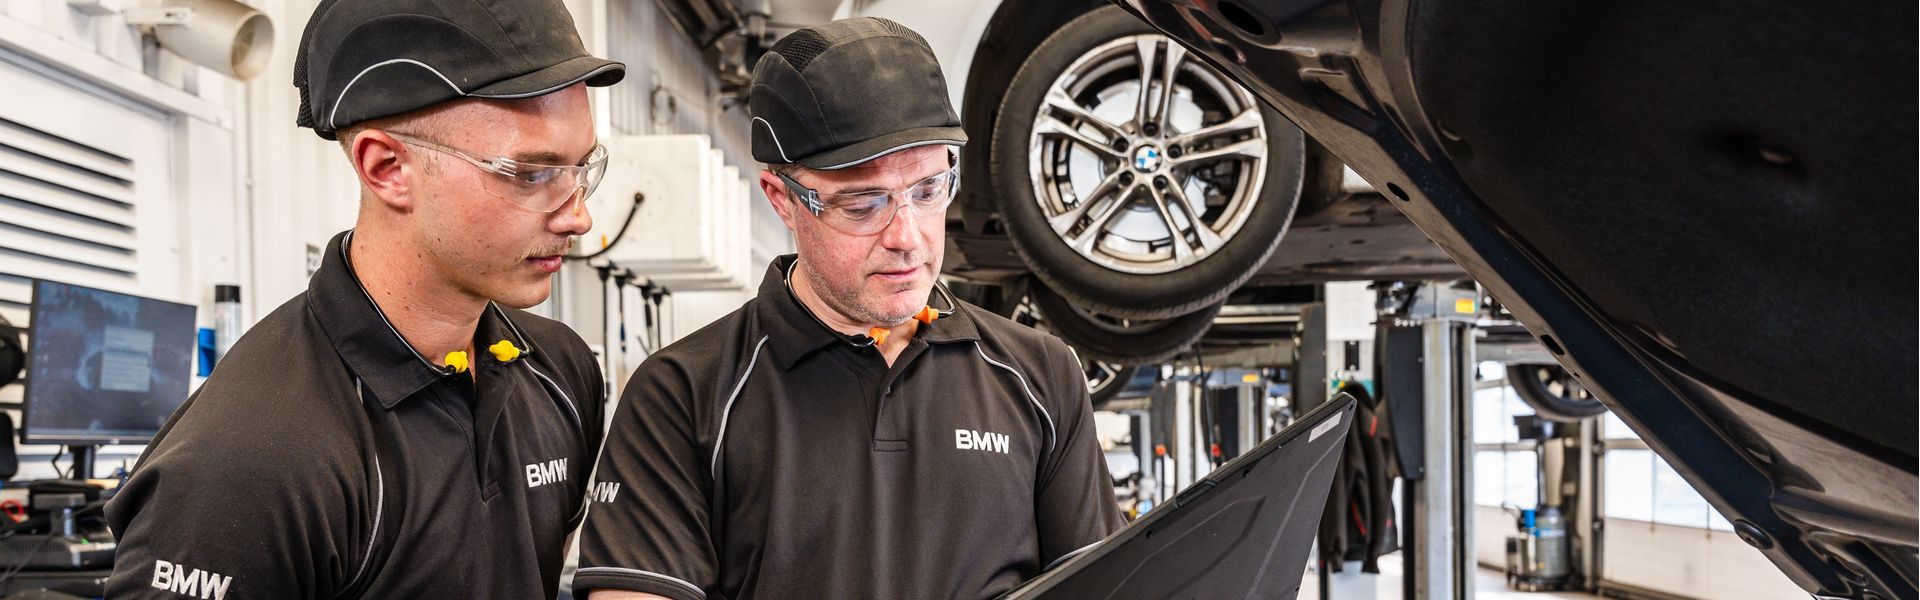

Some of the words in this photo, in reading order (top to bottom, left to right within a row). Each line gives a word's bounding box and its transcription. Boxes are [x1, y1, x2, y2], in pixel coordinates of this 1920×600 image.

[955, 429, 1010, 454] BMW
[525, 457, 568, 488] BMW
[151, 560, 233, 600] BMW
